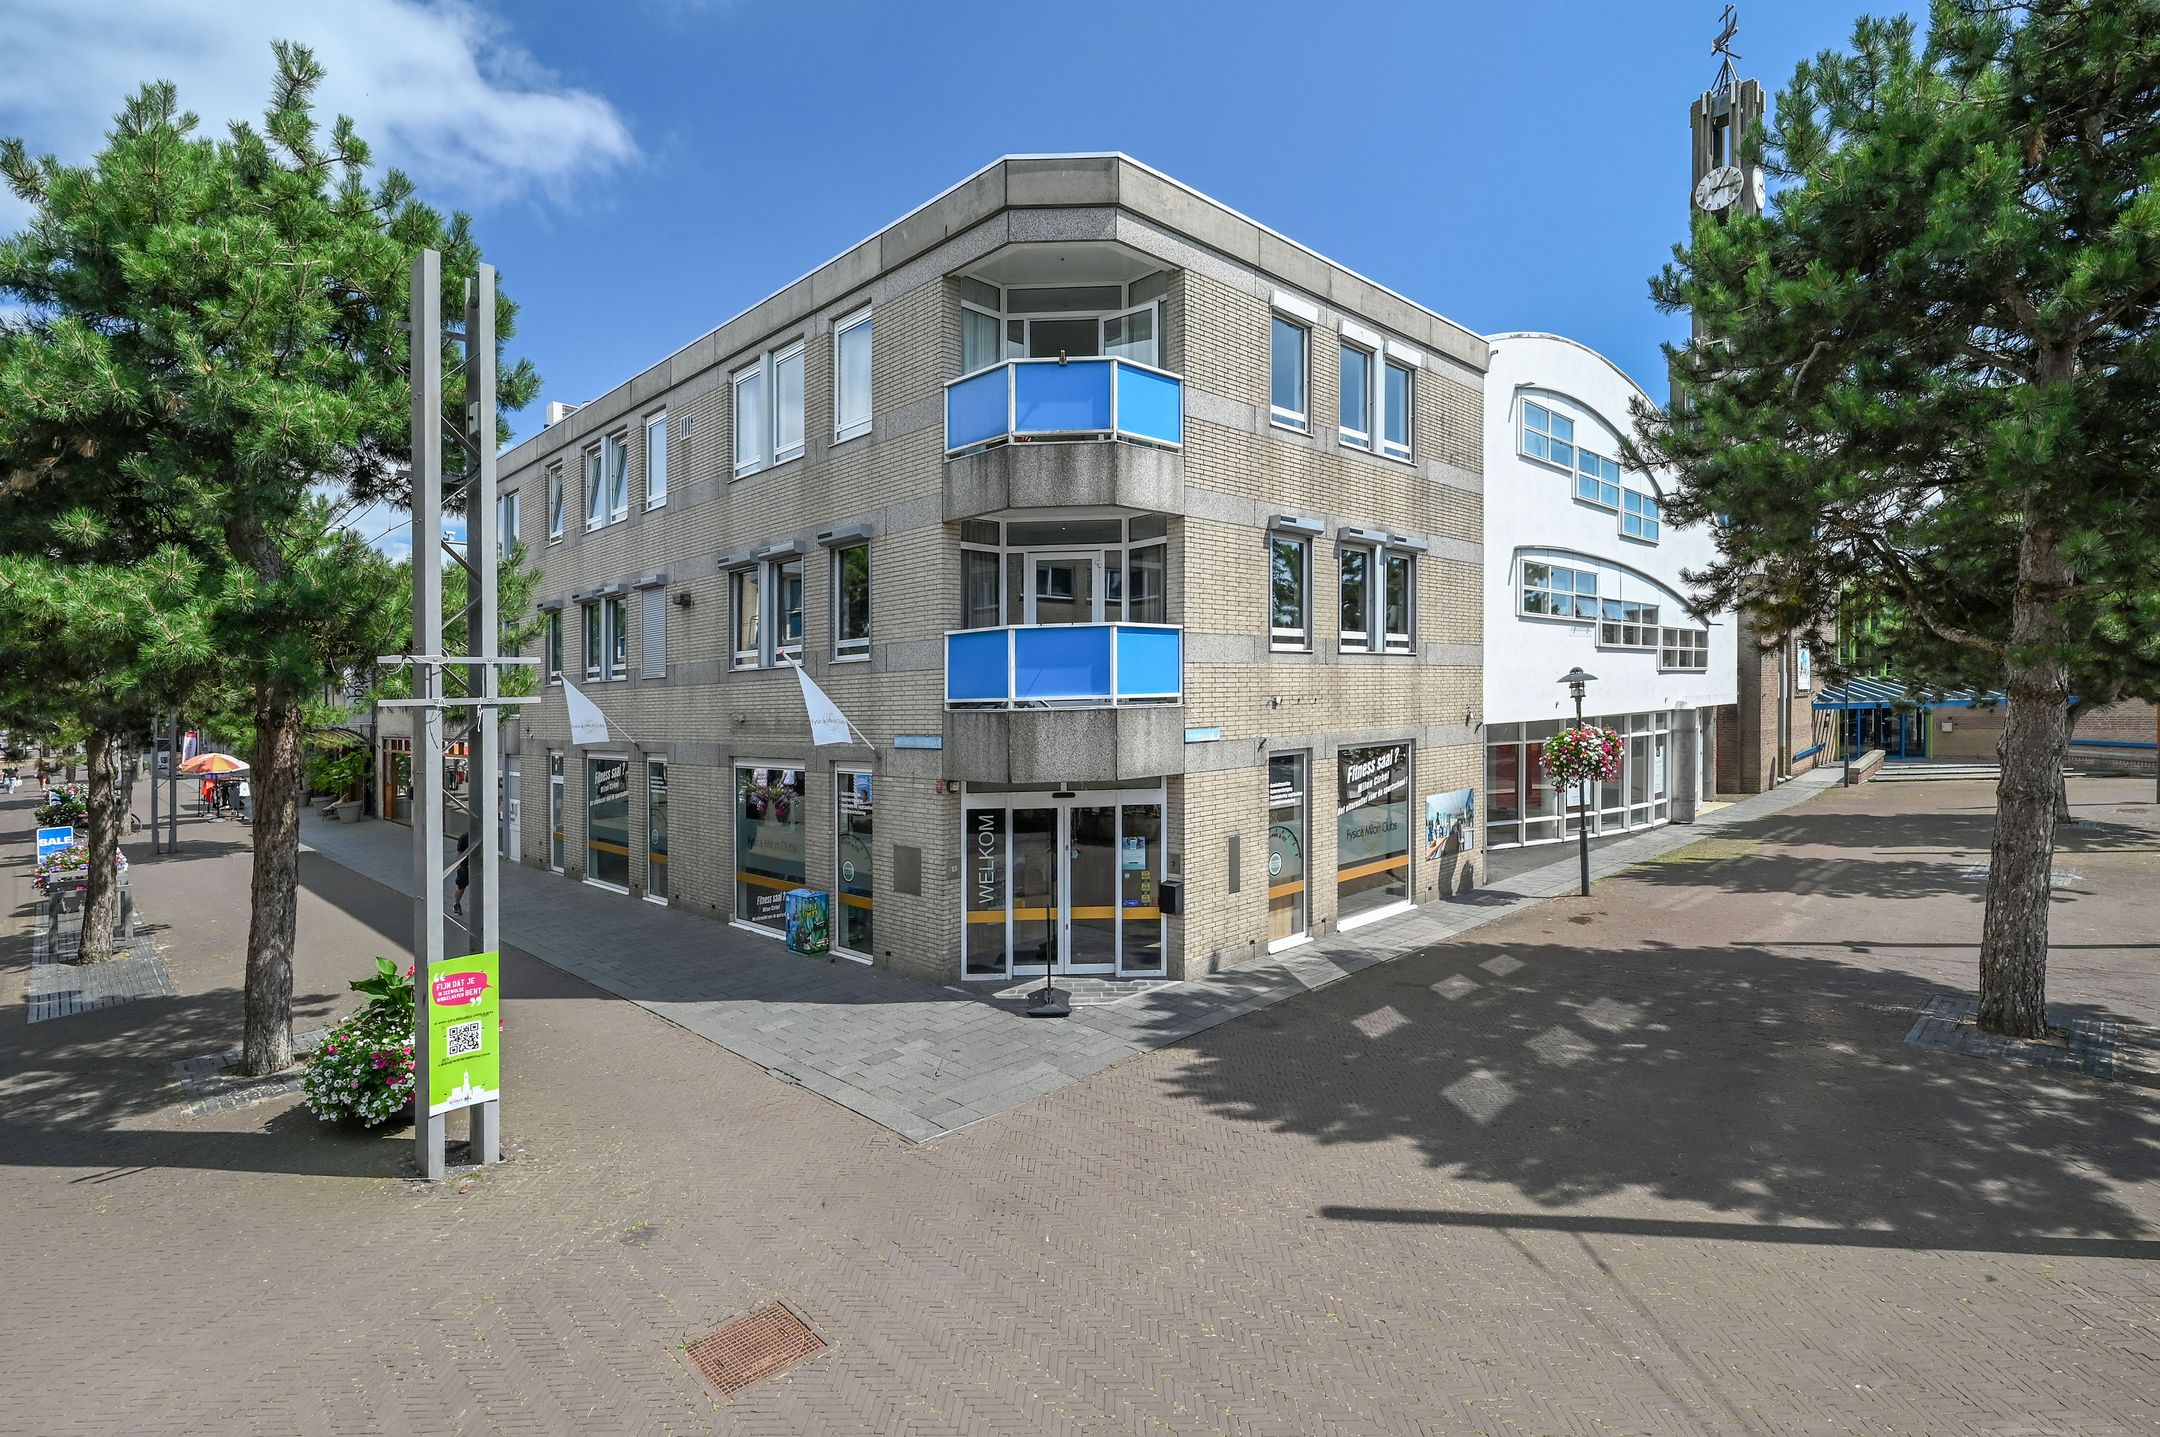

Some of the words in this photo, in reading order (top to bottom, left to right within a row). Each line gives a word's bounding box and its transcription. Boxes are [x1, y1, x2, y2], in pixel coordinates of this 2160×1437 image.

[1346, 758, 1376, 784] Fitness
[1346, 828, 1364, 842] Fysica
[1364, 823, 1381, 837] Milon
[1381, 820, 1398, 832] Clubs
[38, 835, 72, 847] SALE
[978, 815, 995, 904] WELKOM
[436, 981, 451, 991] FIJN
[452, 978, 465, 988] DAT
[466, 976, 476, 985] JE
[465, 987, 482, 997] BENT
